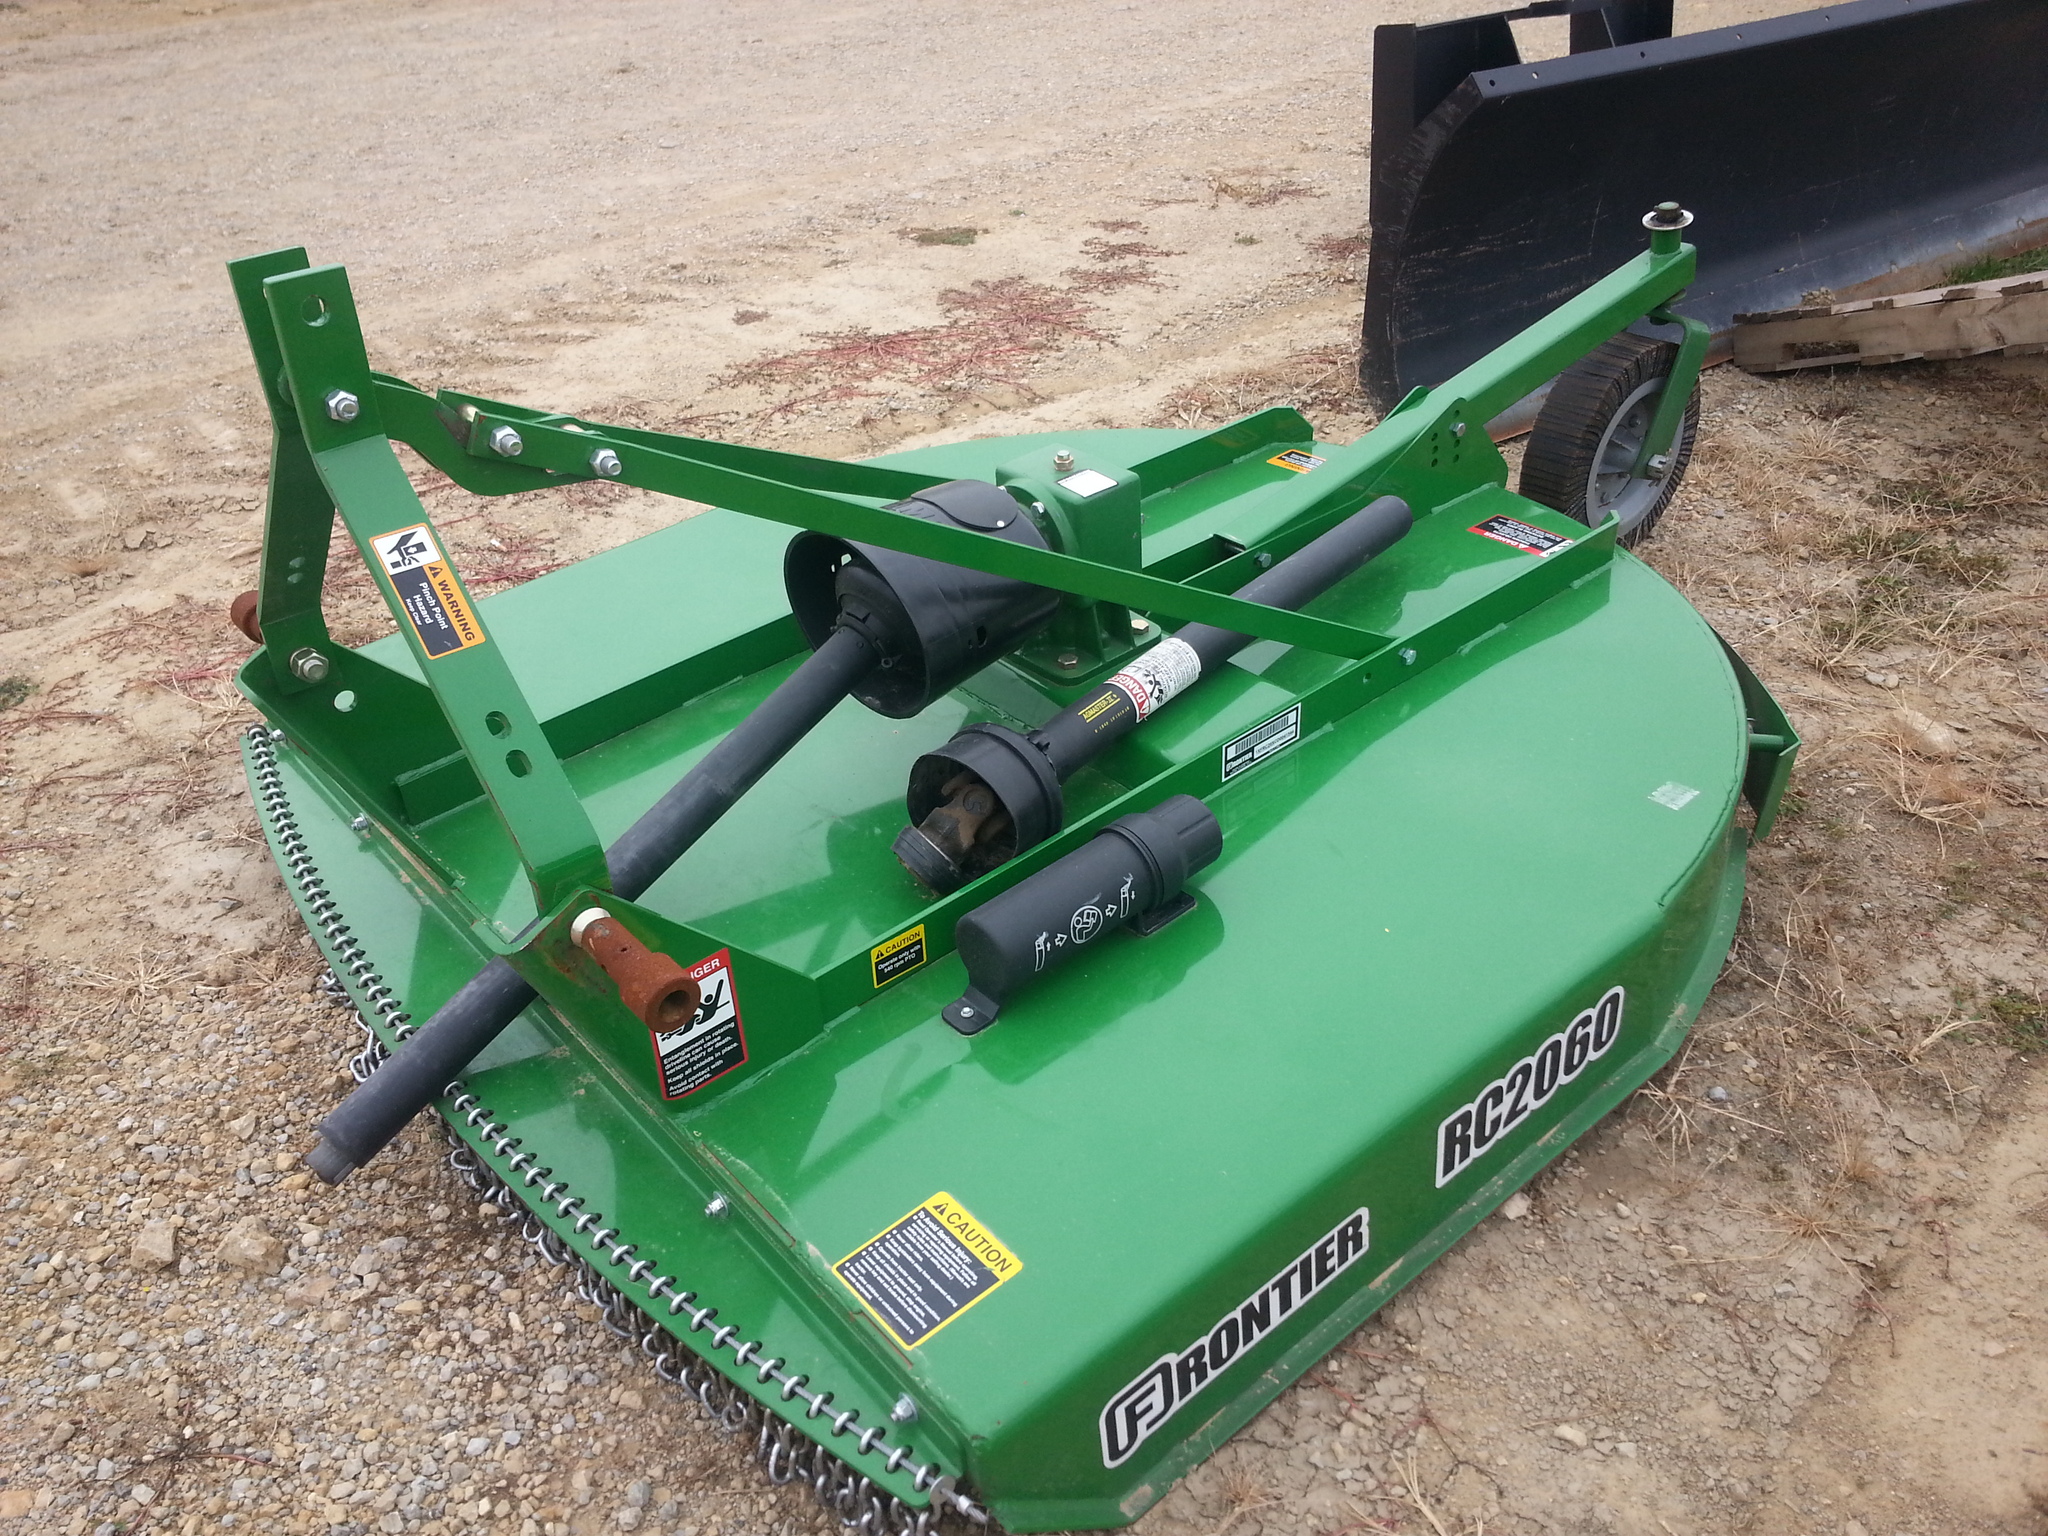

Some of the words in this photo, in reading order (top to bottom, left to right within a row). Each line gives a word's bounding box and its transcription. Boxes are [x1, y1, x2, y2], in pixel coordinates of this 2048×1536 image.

[405, 598, 415, 614] Keep
[412, 612, 422, 626] Clear
[413, 594, 434, 624] Hazard
[419, 582, 436, 607] Pinch
[431, 606, 449, 630] Point
[438, 580, 475, 641] WARNING
[1110, 675, 1147, 703] DANGE
[878, 957, 898, 970] Operate
[898, 949, 909, 960] only
[910, 944, 921, 953] with
[885, 930, 921, 954] CAUTION
[893, 960, 905, 969] rpm
[904, 953, 916, 962] PTO
[664, 1039, 705, 1064] Entanglement
[712, 1022, 735, 1037] rotating
[665, 1053, 691, 1070] driveline
[692, 1047, 703, 1055] can
[704, 1036, 721, 1048] cause
[666, 1061, 689, 1075] serious
[690, 1051, 706, 1063] injury
[715, 1037, 732, 1048] death.
[668, 1074, 684, 1083] Keep
[693, 1056, 714, 1070] shields
[722, 1043, 738, 1055] place.
[669, 1080, 687, 1091] Avoid
[688, 1067, 710, 1082] contact
[711, 1060, 723, 1069] with
[670, 1083, 694, 1095] rotating
[695, 1074, 711, 1085] parts.
[1441, 991, 1621, 1179] RC2060
[918, 1211, 925, 1219] To
[923, 1217, 940, 1232] Avoid
[937, 1230, 957, 1249] Serious
[955, 1247, 972, 1265] Injury:
[946, 1212, 1013, 1273] CAUTION
[1104, 1213, 1364, 1462] FRONTIER
